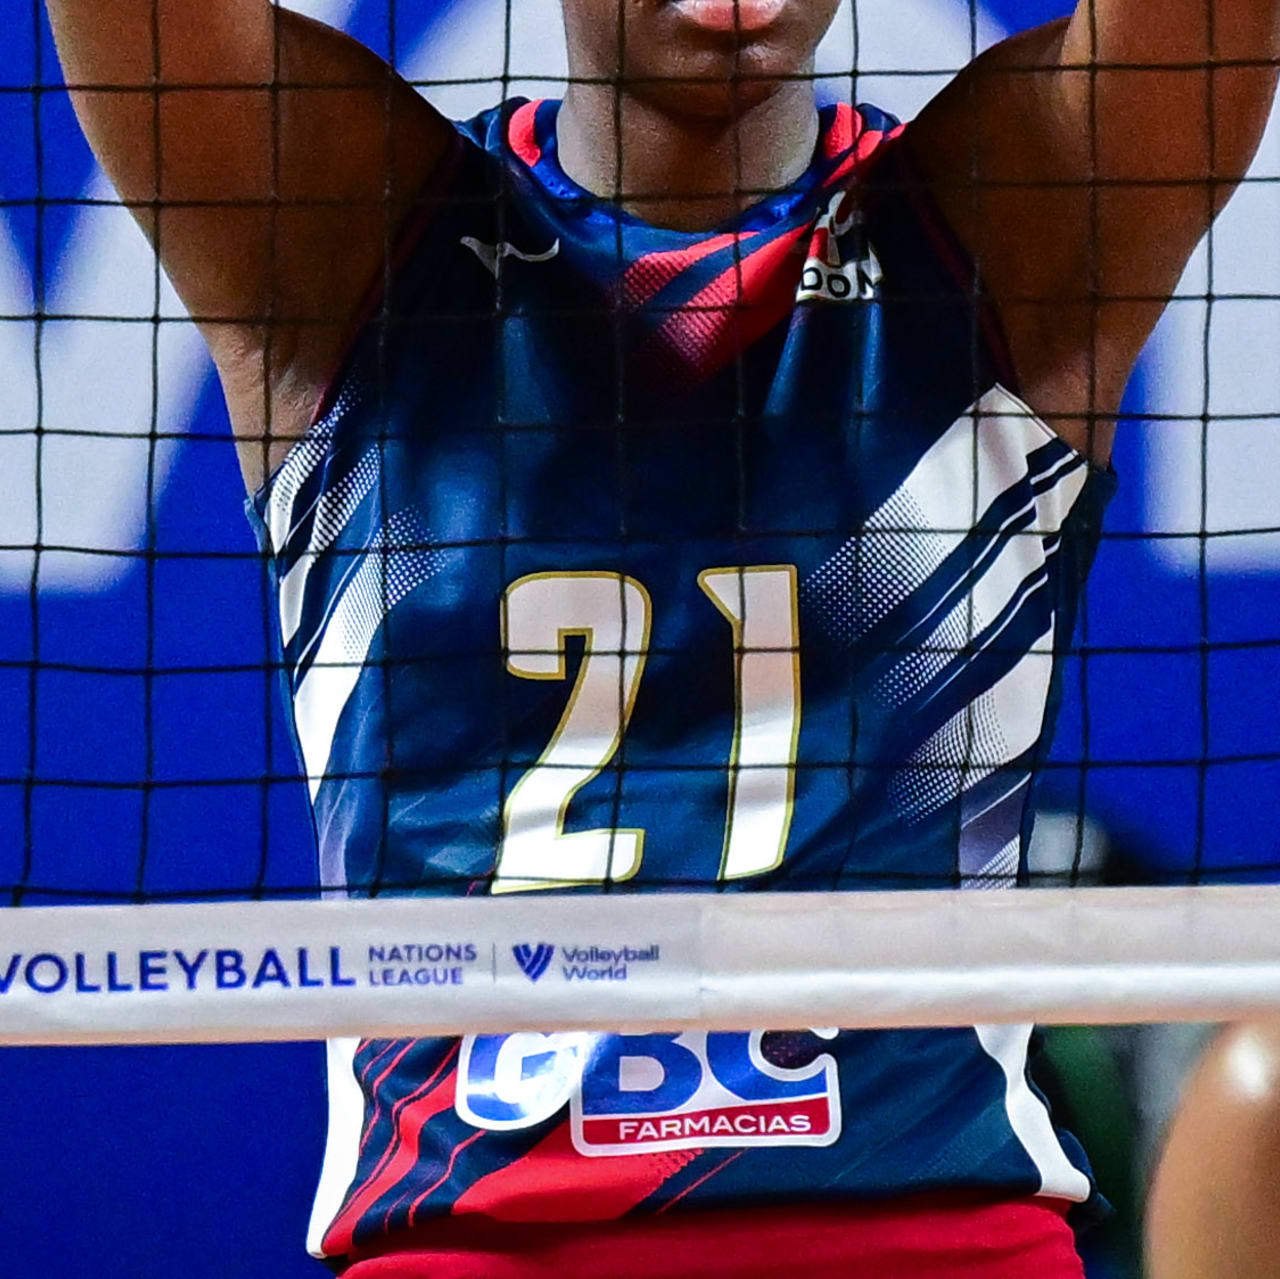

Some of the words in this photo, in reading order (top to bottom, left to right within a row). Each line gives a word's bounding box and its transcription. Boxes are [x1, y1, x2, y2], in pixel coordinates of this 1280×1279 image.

[491, 564, 802, 896] 21
[368, 943, 477, 963] NATIONS
[561, 945, 660, 967] Volleyball
[368, 966, 464, 987] LEAGUE
[562, 963, 628, 981] World
[618, 1113, 812, 1141] FARMACIAS
